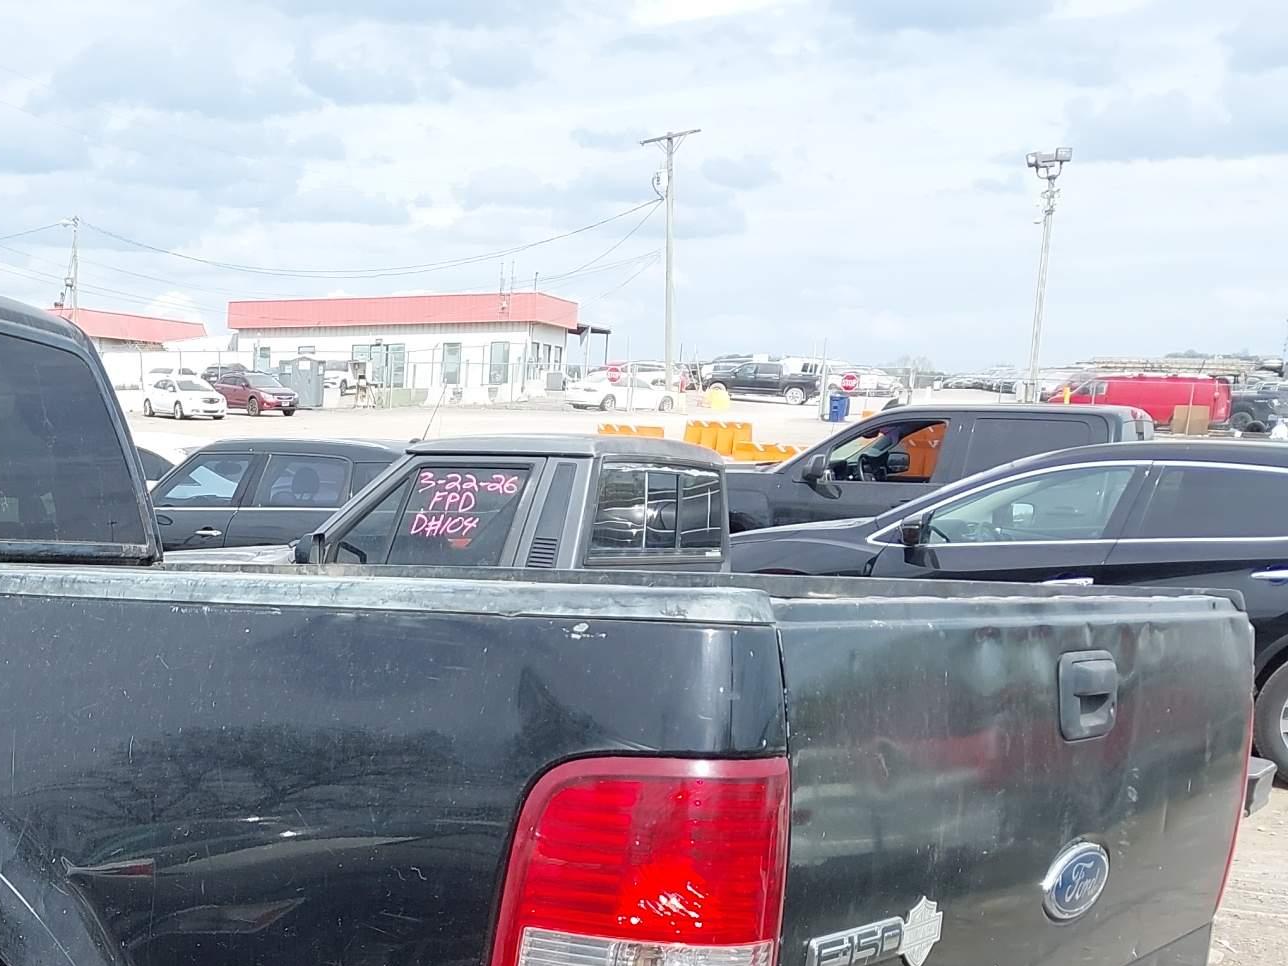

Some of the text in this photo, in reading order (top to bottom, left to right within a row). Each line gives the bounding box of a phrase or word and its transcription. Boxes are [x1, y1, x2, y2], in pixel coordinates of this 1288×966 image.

[418, 472, 518, 494] 3-22-26
[429, 491, 475, 512] FPD
[411, 513, 479, 537] D#104
[1065, 860, 1101, 903] Ford
